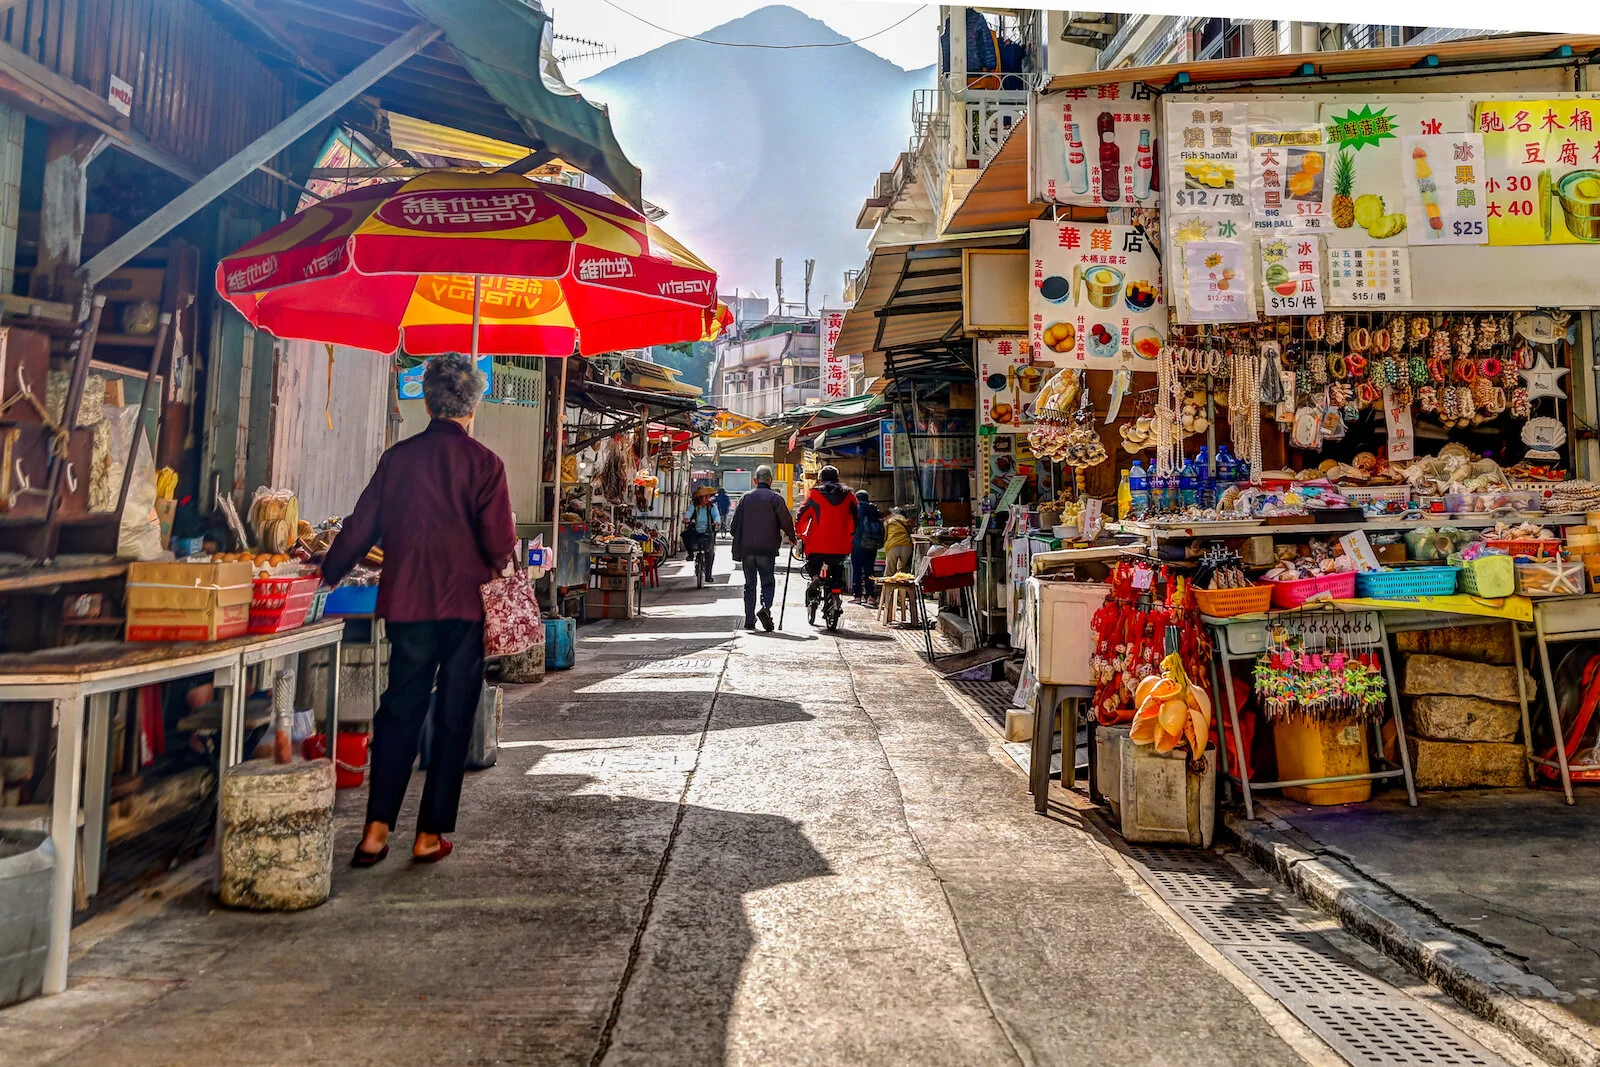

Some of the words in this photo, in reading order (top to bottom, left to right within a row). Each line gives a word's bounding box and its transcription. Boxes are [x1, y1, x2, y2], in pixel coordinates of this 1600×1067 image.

[1192, 110, 1223, 124] 魚肉
[1480, 108, 1593, 133] 馳名木桶
[1183, 127, 1233, 148] 燒賣
[1180, 151, 1198, 159] Fish
[1199, 151, 1238, 159] ShaoMai
[1261, 149, 1282, 208] 大魚旦
[1453, 142, 1475, 208] 冰果串
[1486, 177, 1500, 193] 小
[1506, 175, 1532, 192] 30
[401, 193, 535, 213] 維他奶
[1176, 189, 1207, 207] $12
[1297, 203, 1323, 215] $12
[1487, 202, 1502, 218] 大
[1508, 200, 1533, 216] 40
[1218, 220, 1237, 238] 冰
[1254, 220, 1272, 228] FISH
[1274, 218, 1294, 228] BALL
[1305, 219, 1321, 228] 2粒
[1453, 220, 1483, 236] $25
[579, 257, 634, 280] 維他奶
[1080, 254, 1127, 265] 木桶豆腐花
[1298, 242, 1315, 292] 冰西瓜
[226, 254, 280, 292] 維他奶
[1302, 295, 1317, 309] 件
[1121, 317, 1130, 346] 豆腐花
